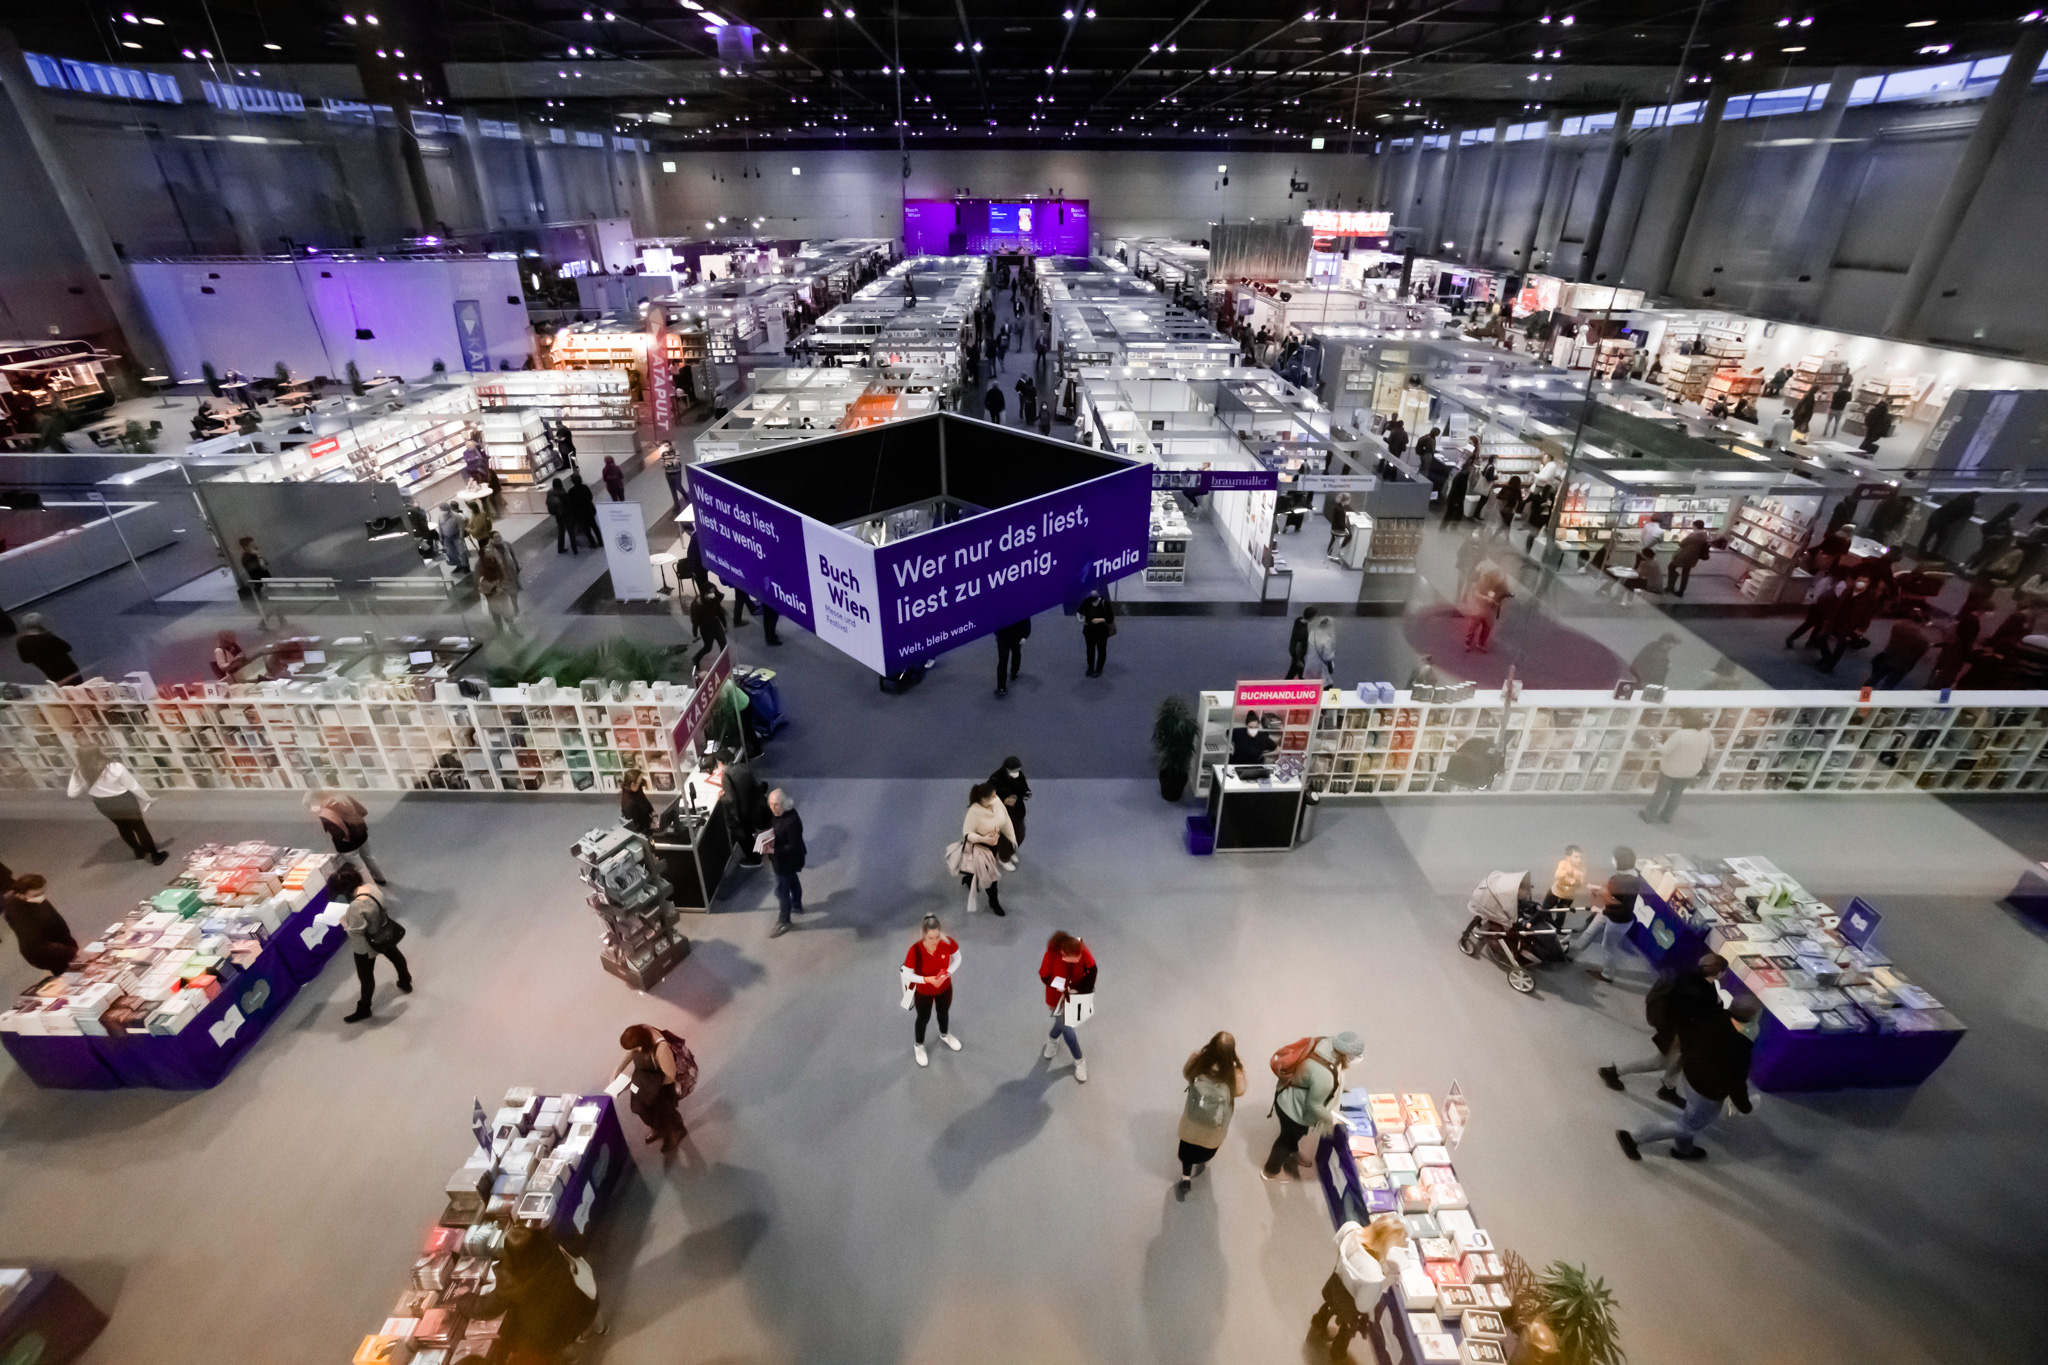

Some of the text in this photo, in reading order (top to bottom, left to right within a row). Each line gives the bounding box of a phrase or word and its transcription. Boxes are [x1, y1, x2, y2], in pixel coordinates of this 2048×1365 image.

[651, 349, 670, 431] ATAPULT
[1211, 475, 1269, 486] braumüller
[694, 483, 780, 543] Wer nur das liest,
[698, 508, 766, 560] liest zu wenig.
[892, 504, 1090, 588] Wer nur das liest,
[819, 554, 860, 594] Buch
[1093, 549, 1140, 578] Thalia
[771, 581, 807, 615] Thalia
[827, 582, 871, 624] Wien
[896, 549, 1058, 625] liest zu wenig.
[825, 604, 857, 628] Messe und
[826, 614, 848, 633] Festival
[899, 620, 977, 658] Welt, bleib wach.
[207, 688, 214, 696] R
[686, 676, 721, 733] KASSA
[1240, 690, 1316, 701] BUCHHANDLUNG
[1331, 693, 1338, 702] A
